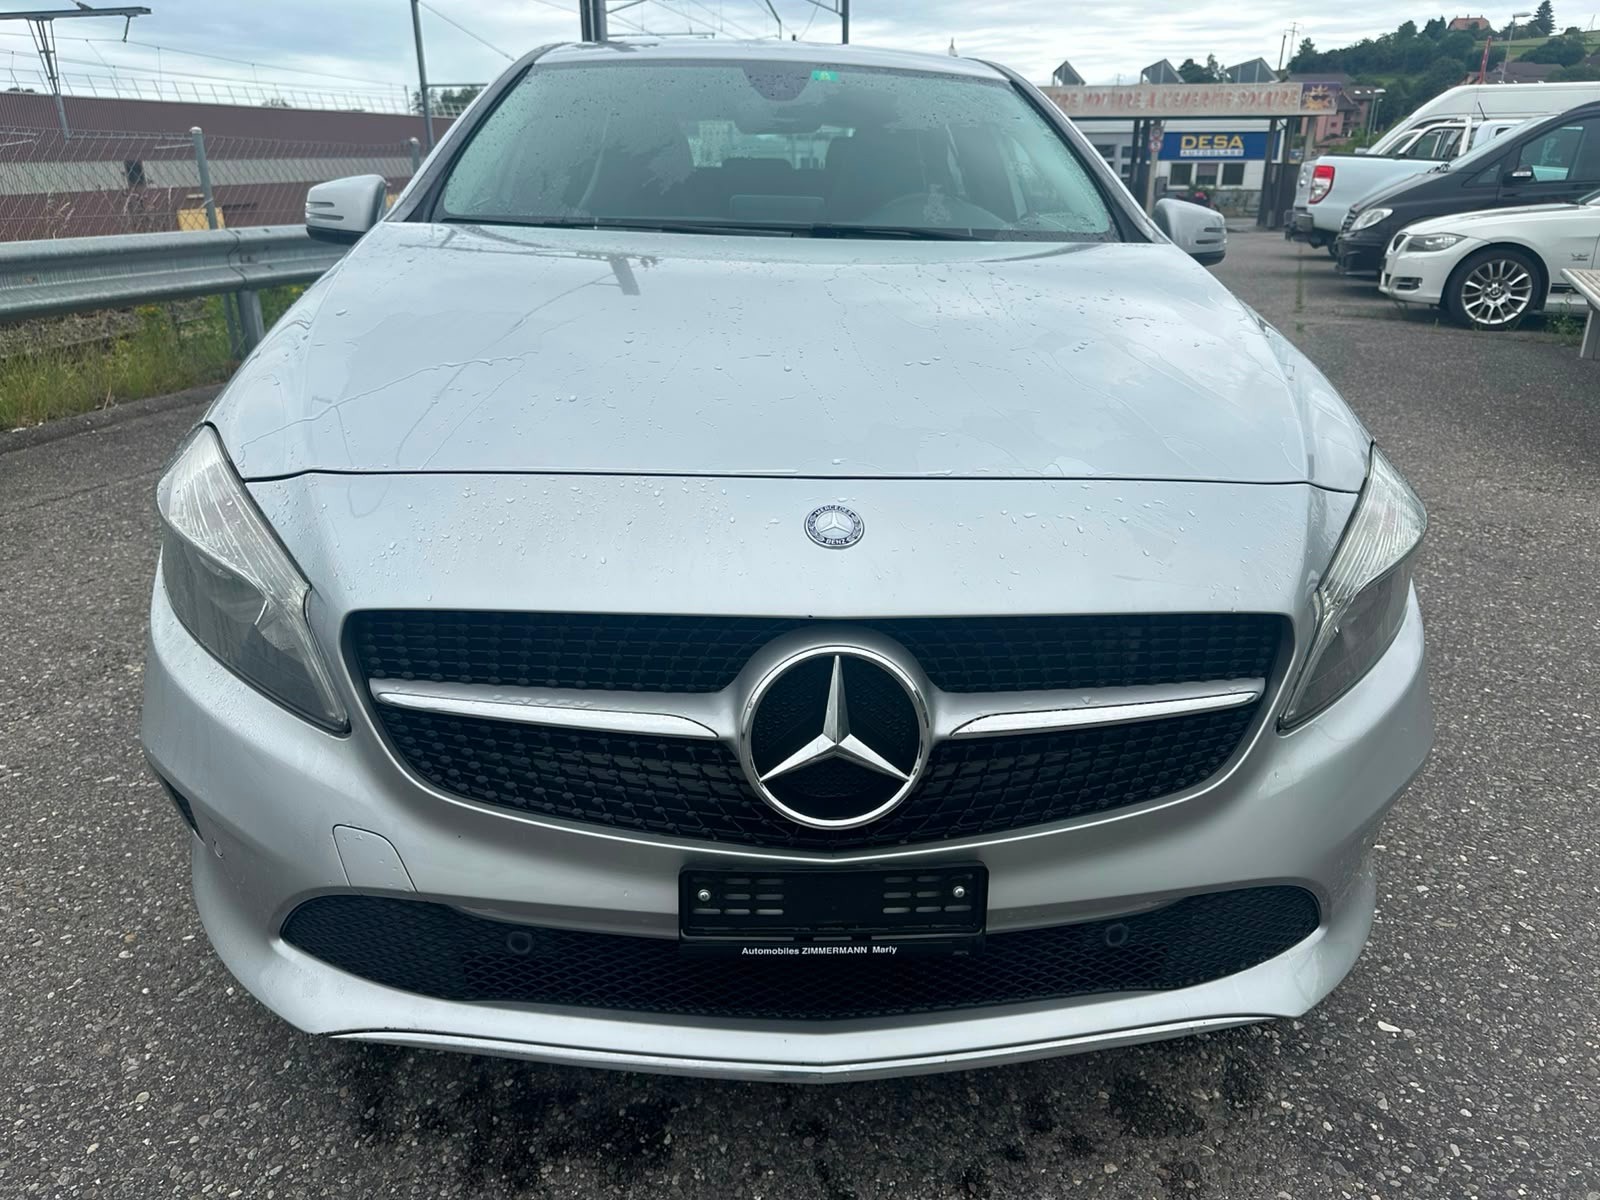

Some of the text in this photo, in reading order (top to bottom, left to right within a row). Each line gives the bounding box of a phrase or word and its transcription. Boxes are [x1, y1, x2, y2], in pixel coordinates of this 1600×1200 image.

[1181, 135, 1244, 149] DESA
[741, 945, 898, 955] Automobiles ZIMMERMANN Marly
